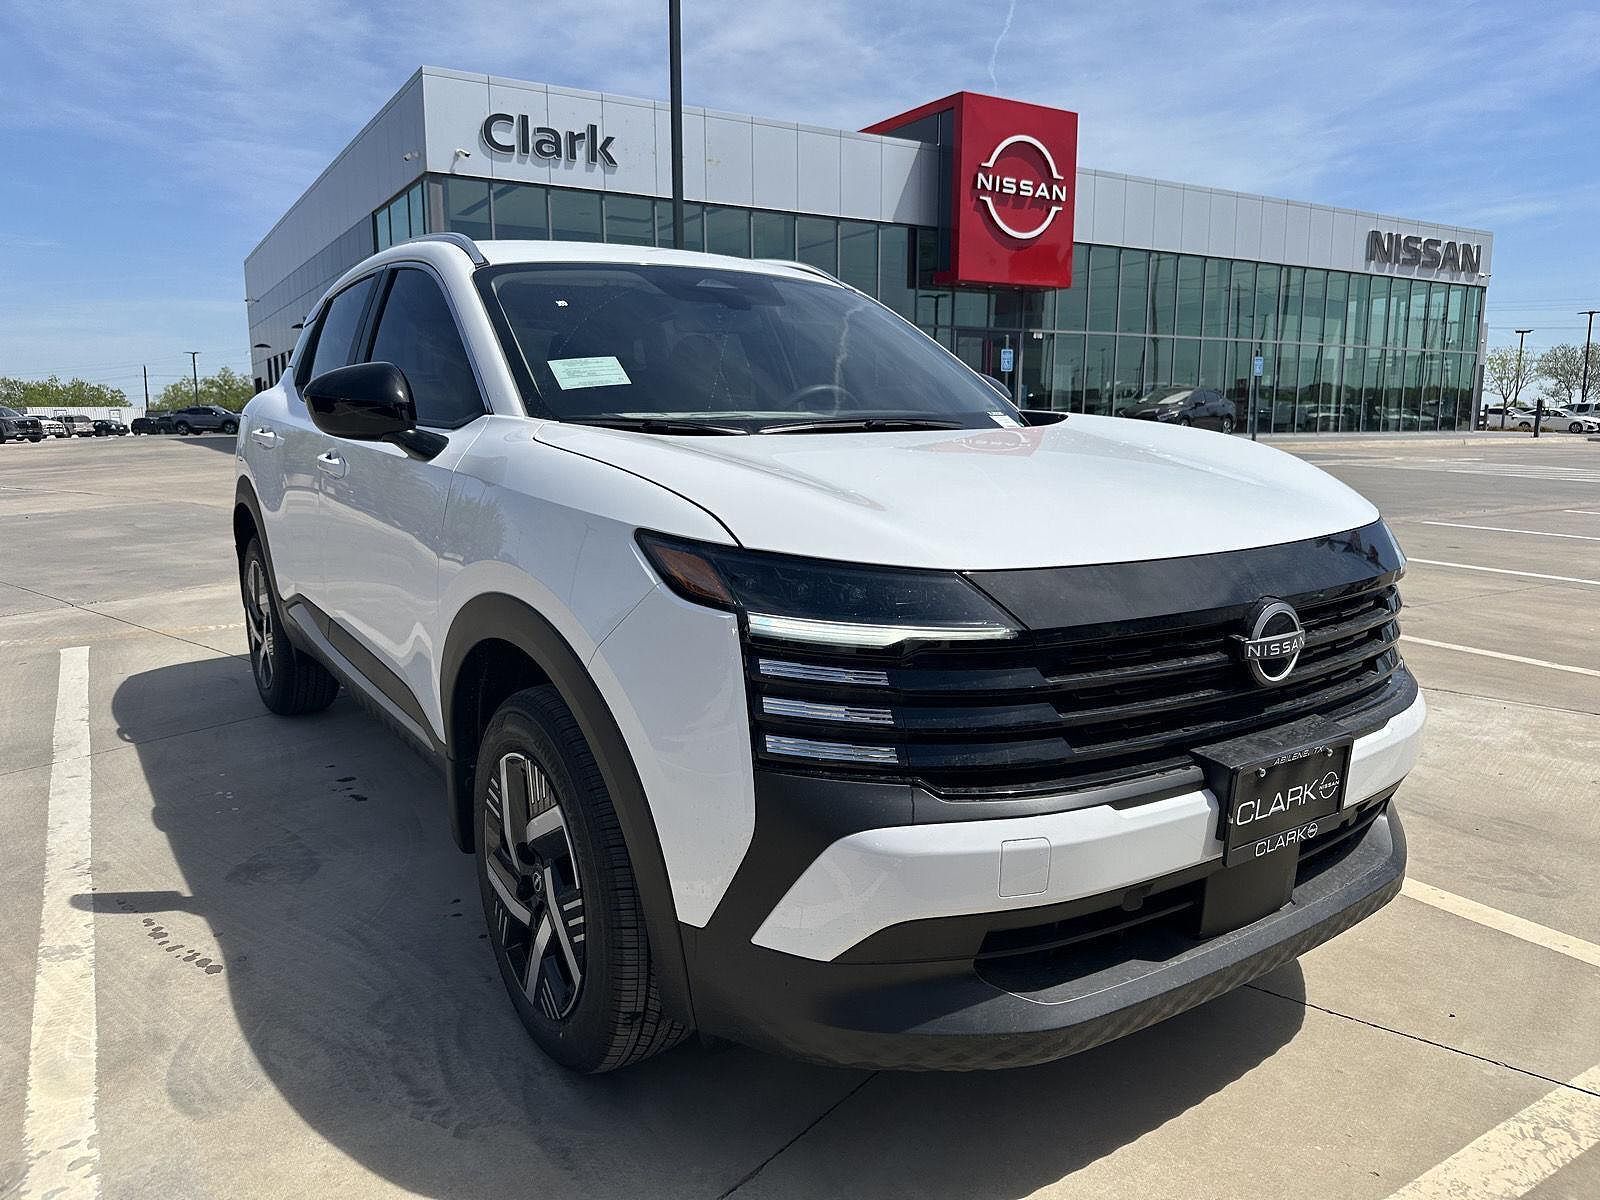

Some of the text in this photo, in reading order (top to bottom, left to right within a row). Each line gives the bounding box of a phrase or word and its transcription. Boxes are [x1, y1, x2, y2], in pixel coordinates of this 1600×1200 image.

[482, 113, 617, 167] Clark
[977, 172, 1067, 202] NISSAN
[1366, 230, 1481, 273] NISSAN
[1247, 636, 1305, 657] NISSAN
[1236, 779, 1318, 826] CLARK
[1255, 825, 1308, 857] CLARK
